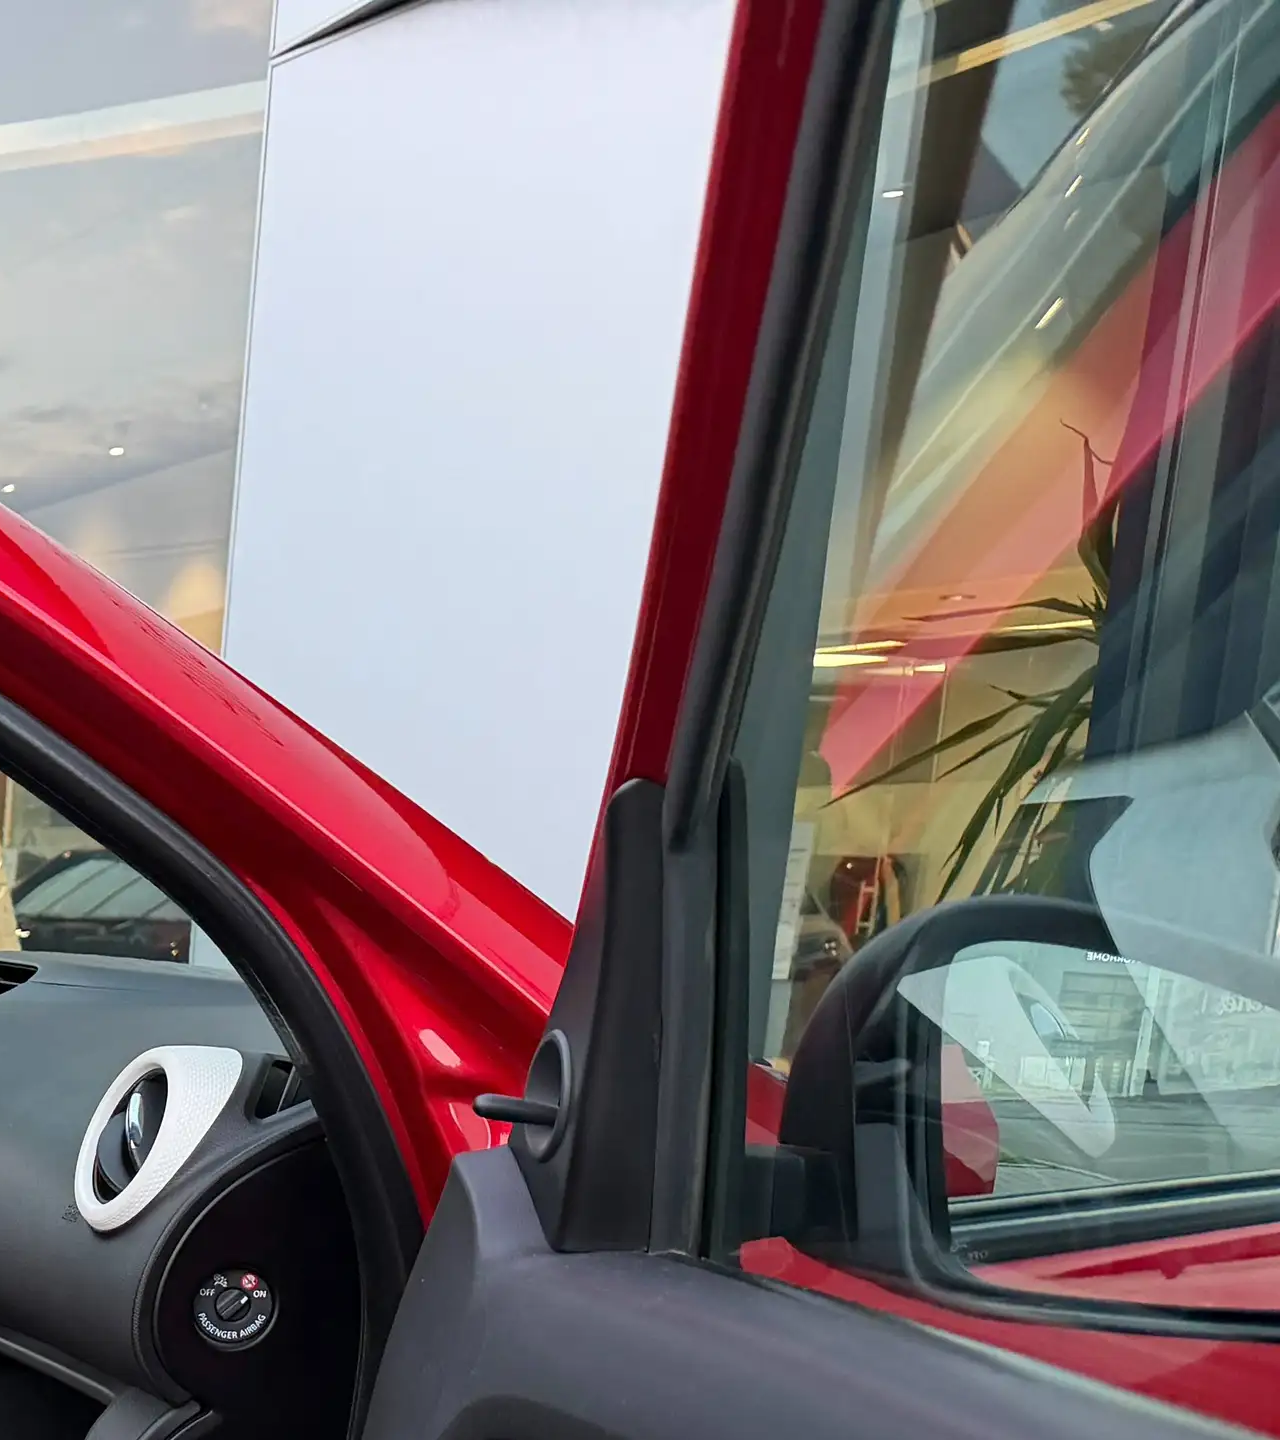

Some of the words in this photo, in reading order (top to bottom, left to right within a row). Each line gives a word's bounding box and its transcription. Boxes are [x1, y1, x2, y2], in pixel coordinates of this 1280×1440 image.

[199, 1288, 215, 1296] OFF
[253, 1290, 267, 1298] ON
[197, 1312, 239, 1340] PASSENGER
[239, 1313, 267, 1338] AIRBAG
